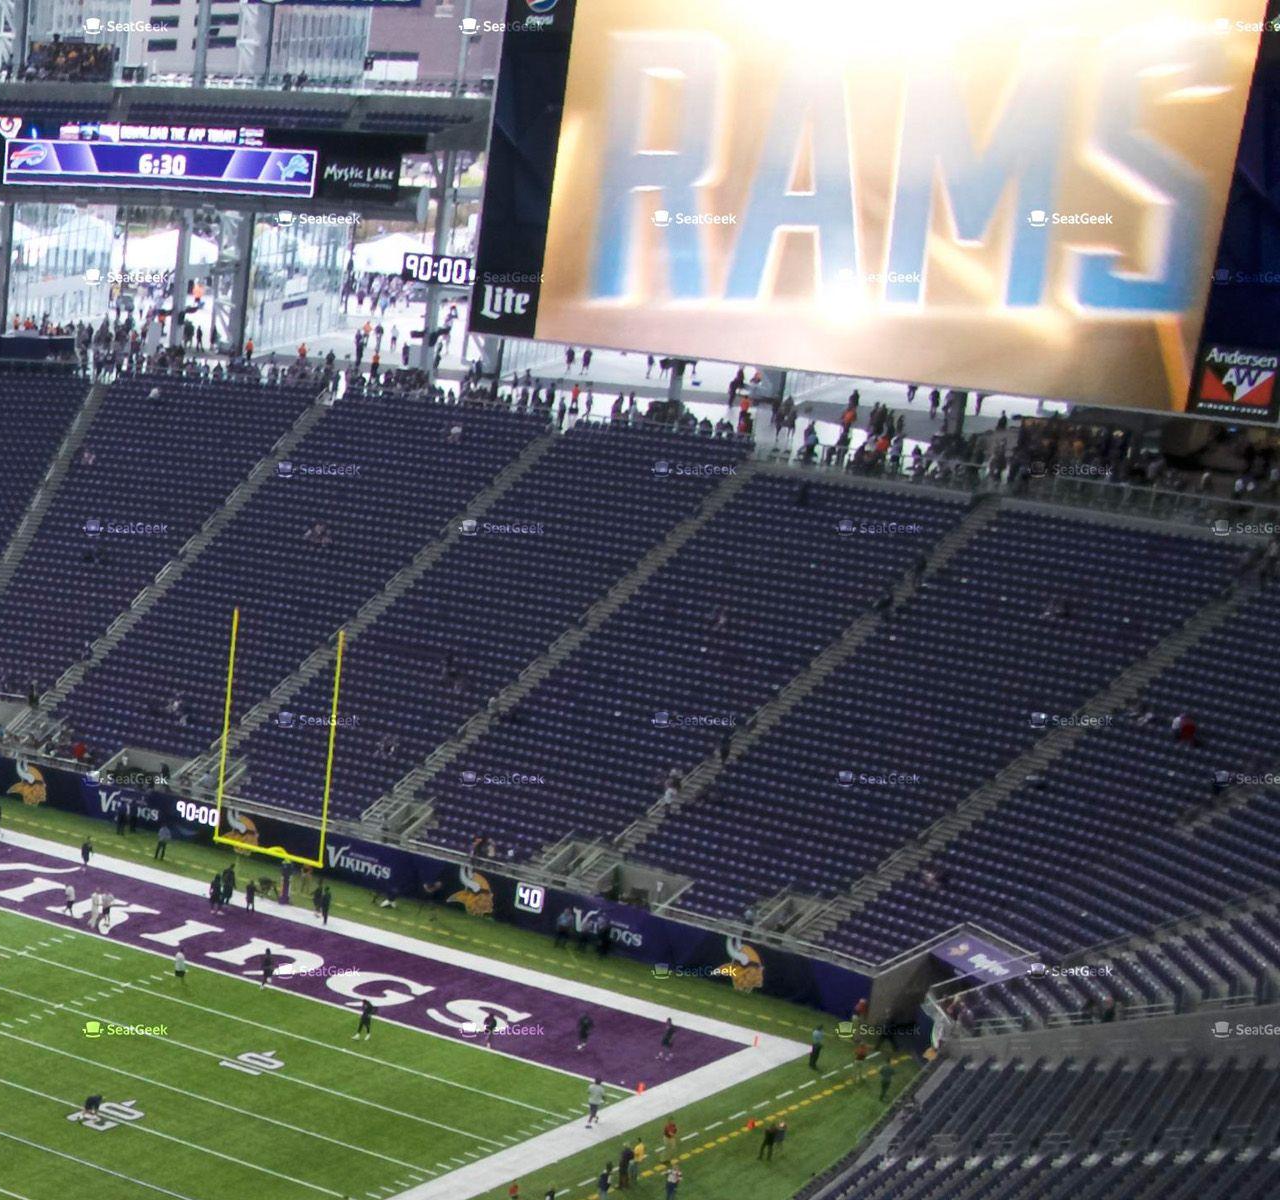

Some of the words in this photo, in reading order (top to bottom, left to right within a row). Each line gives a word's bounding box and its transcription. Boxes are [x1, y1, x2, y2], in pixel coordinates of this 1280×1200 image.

[138, 153, 187, 176] 6:30
[591, 28, 1213, 314] RAMS
[405, 254, 467, 285] 90:00
[478, 283, 531, 319] Lite
[1205, 347, 1278, 367] Andersen
[176, 800, 220, 828] 90:00
[326, 844, 392, 880] VIKINGS
[517, 886, 543, 910] 40
[219, 1051, 285, 1075] 10
